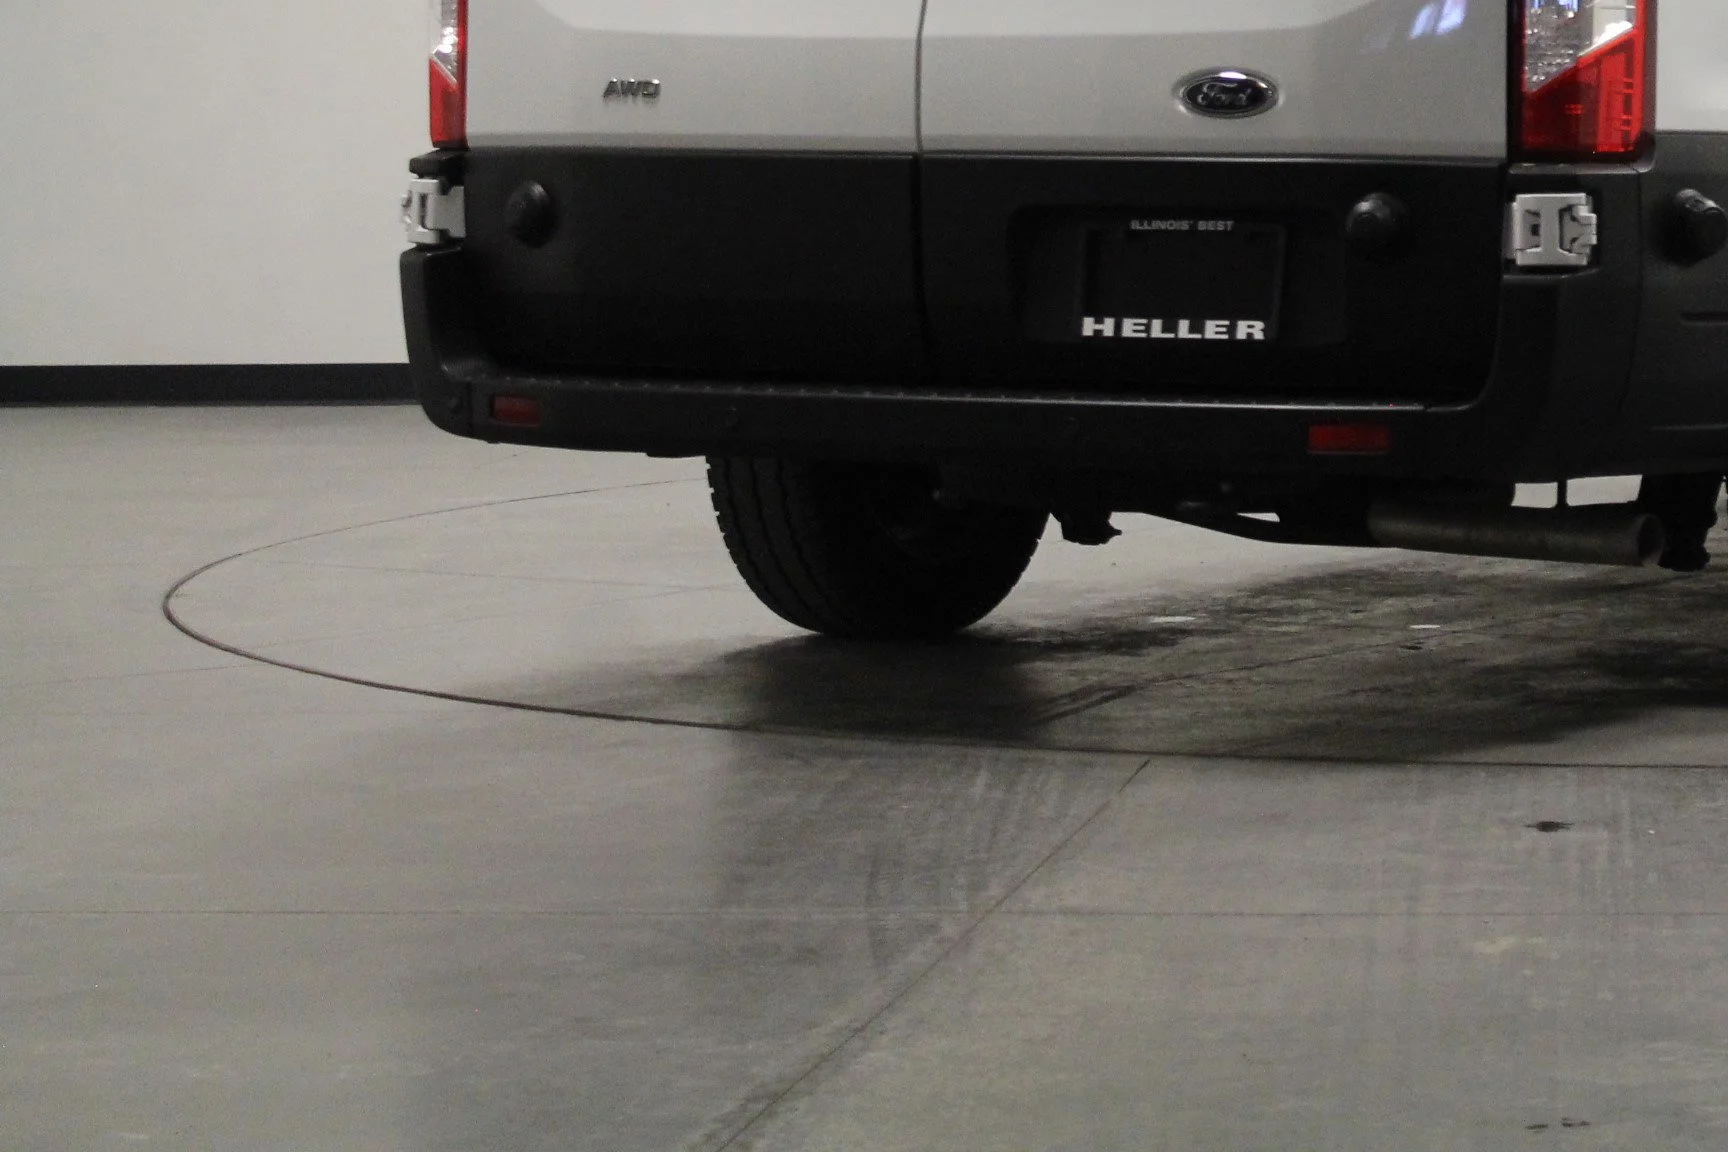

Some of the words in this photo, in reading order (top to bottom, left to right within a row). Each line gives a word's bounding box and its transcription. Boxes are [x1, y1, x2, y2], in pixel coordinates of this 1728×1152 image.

[602, 78, 661, 99] AWD
[1197, 220, 1235, 231] BEST
[1081, 316, 1266, 340] HELLER
